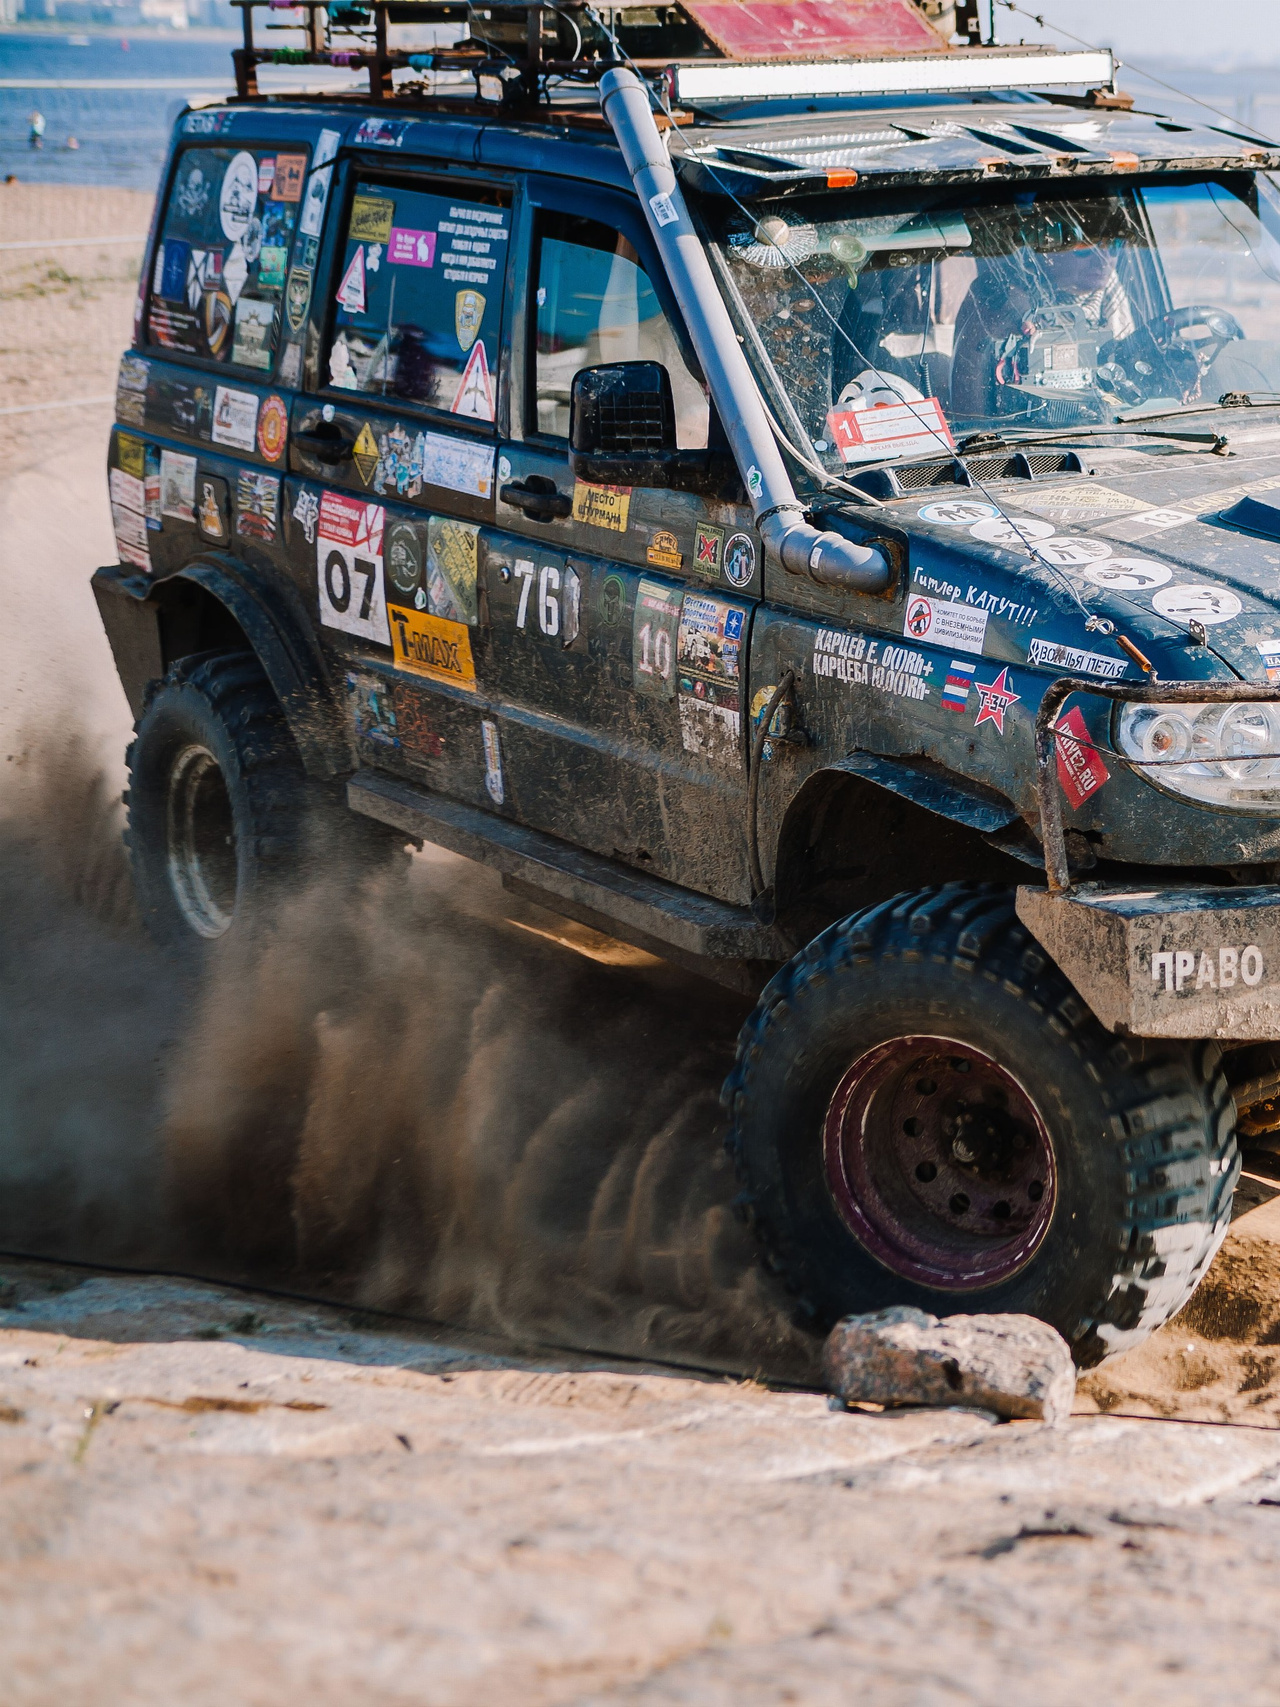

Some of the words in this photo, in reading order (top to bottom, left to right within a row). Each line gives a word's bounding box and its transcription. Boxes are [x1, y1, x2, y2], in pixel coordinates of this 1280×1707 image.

[587, 488, 615, 507] МЕСТО
[578, 504, 622, 525] ШТУРМАНА
[1144, 512, 1183, 524] 13
[324, 549, 376, 621] 07
[912, 566, 962, 603] Гитлер
[965, 584, 1039, 628] КАПУТ!!!
[936, 609, 959, 620] КОМИТЕТ
[966, 615, 987, 625] БОРЬБЕ
[941, 618, 985, 634] ВНЕЗЕМНЫМИ
[392, 609, 463, 675] T-MAX
[814, 628, 866, 660] КАРЦЕВ
[934, 627, 983, 644] ЦИВИЛИЗАЦИЯМИ
[638, 622, 672, 680] 10
[1086, 657, 1128, 679] ПЕТЛЯ
[980, 690, 1008, 714] Т-34
[1058, 722, 1097, 792] DRIVE2.RU
[1151, 945, 1264, 992] ПРАВО
